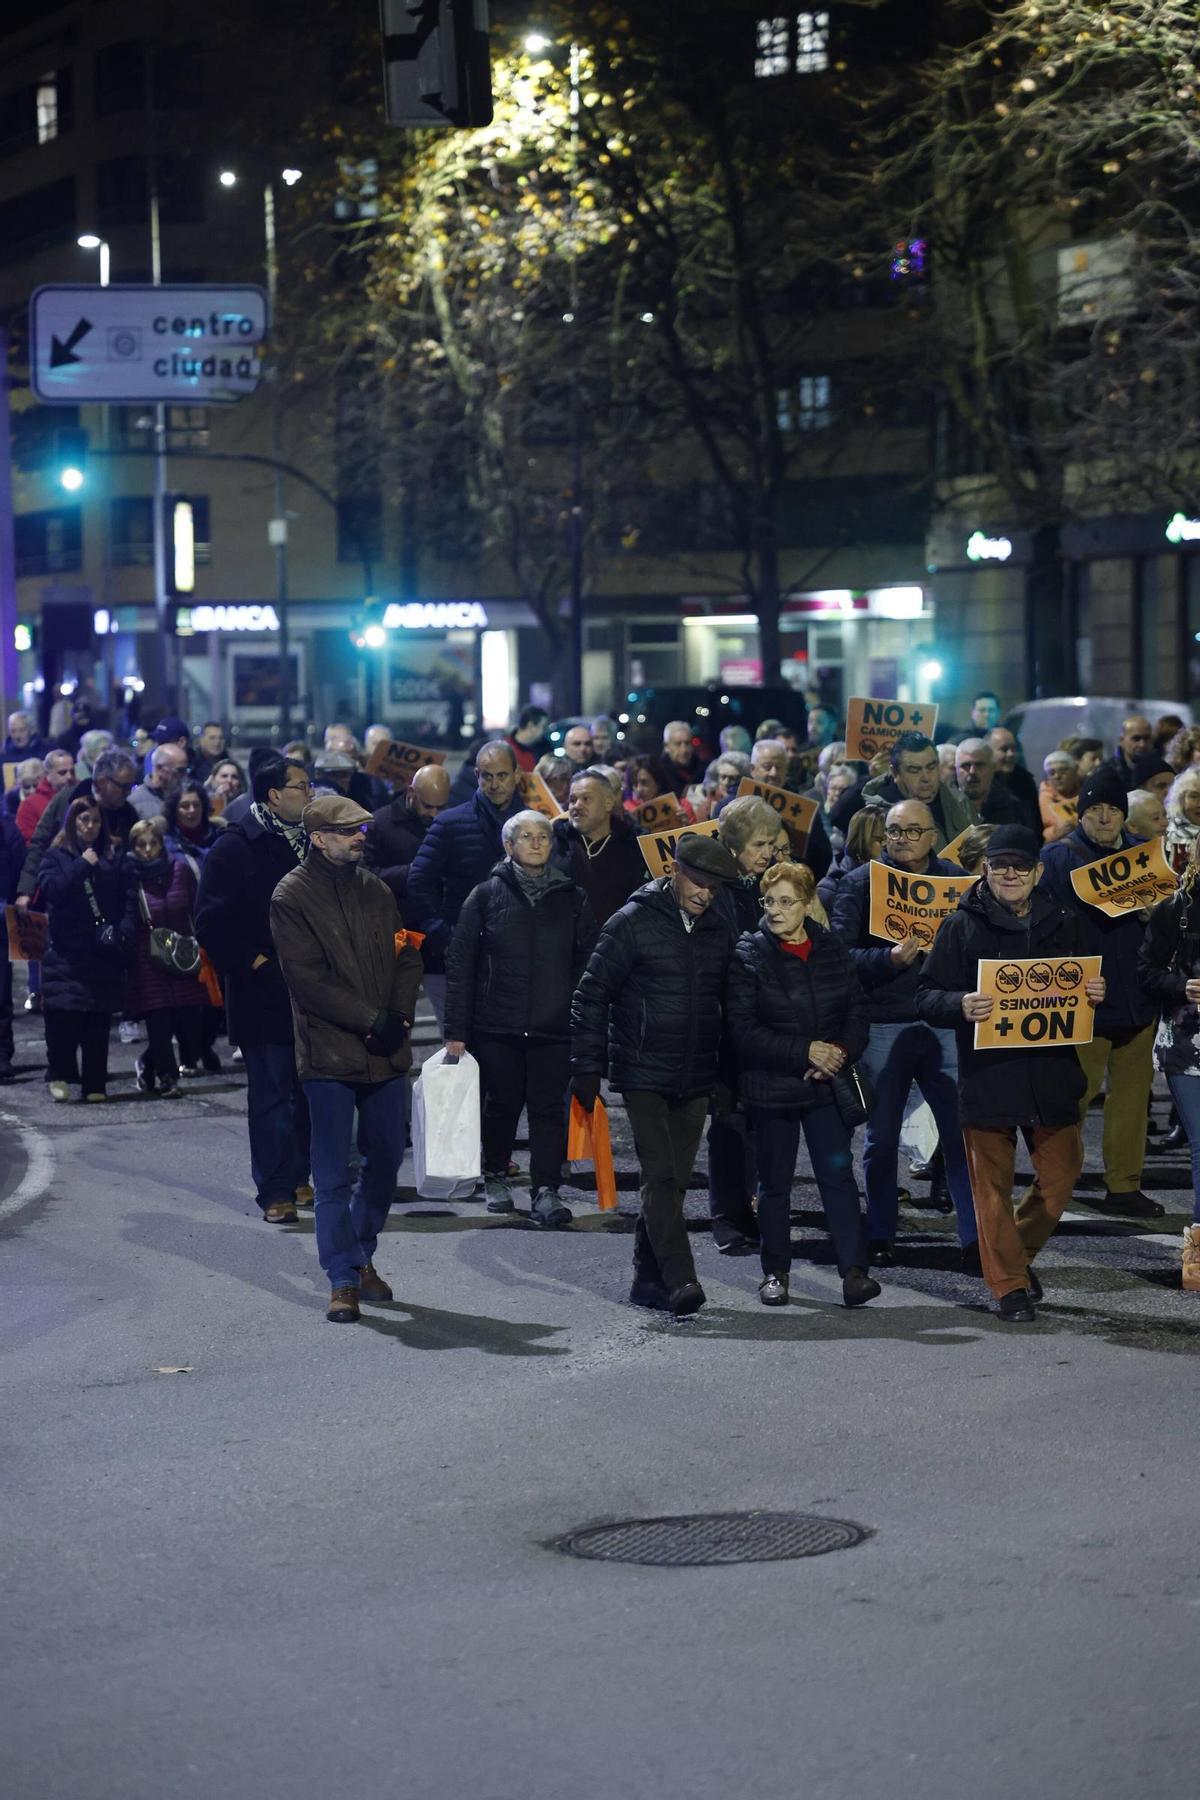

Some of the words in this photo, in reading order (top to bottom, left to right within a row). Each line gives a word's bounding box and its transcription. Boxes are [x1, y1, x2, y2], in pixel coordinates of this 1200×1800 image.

[153, 313, 252, 335] centro
[190, 605, 280, 631] BANCA
[382, 602, 488, 628] ABANCA
[863, 703, 904, 727] NO
[387, 743, 421, 762] NO
[1088, 856, 1131, 892] NO
[1099, 872, 1157, 898] CAMIONES
[888, 872, 936, 905] NO
[1000, 995, 1079, 1010] CAMIONES
[1021, 1011, 1075, 1041] NO
